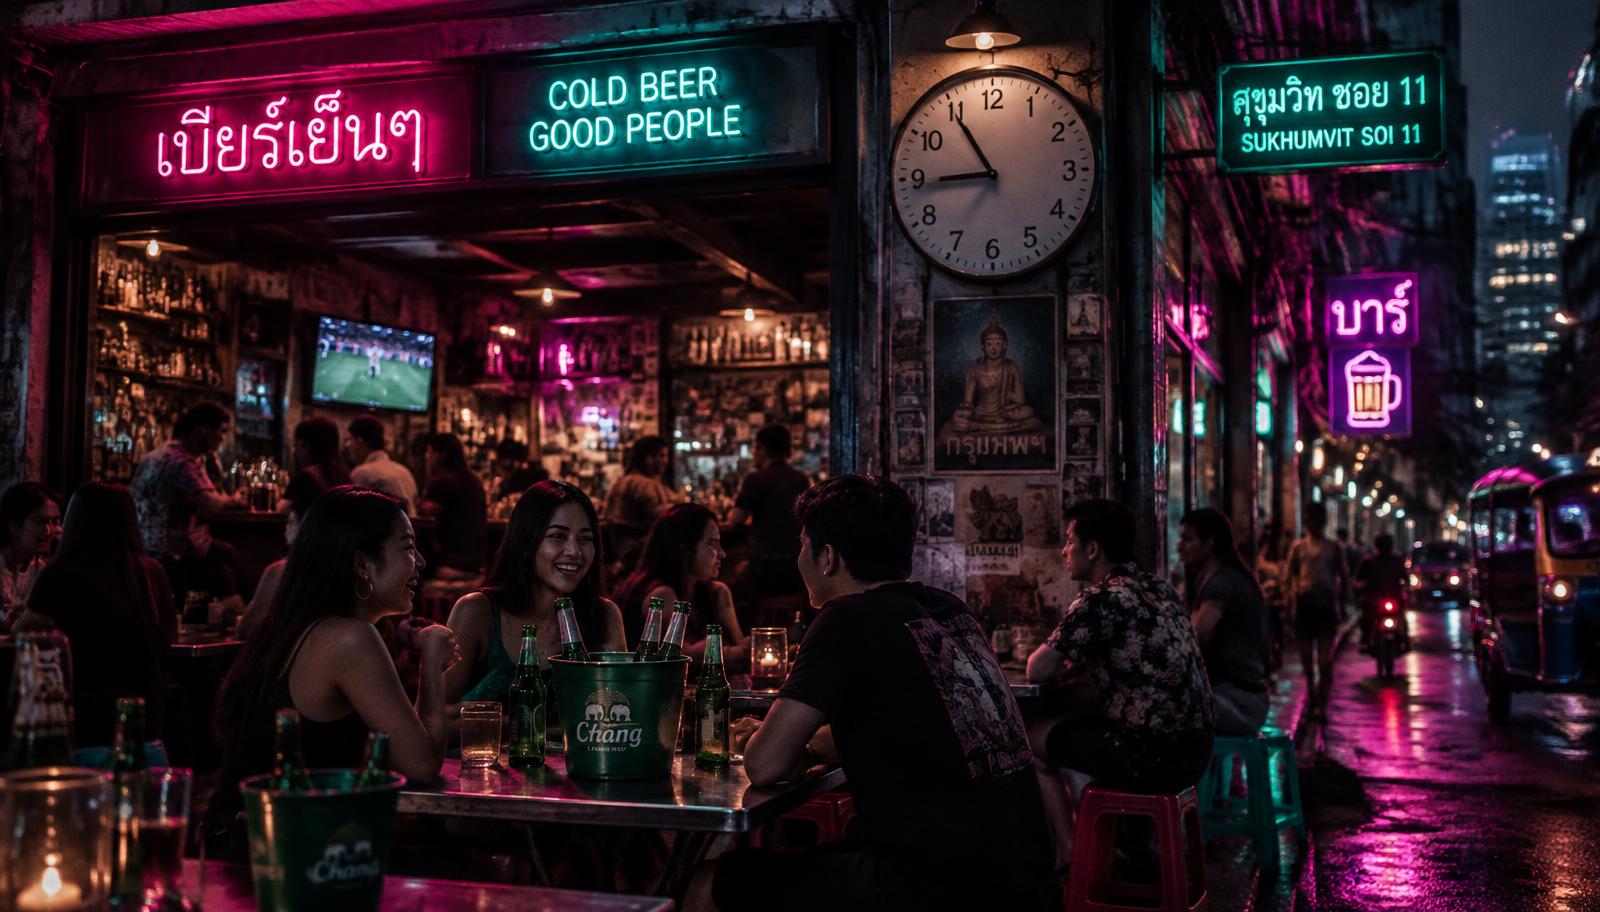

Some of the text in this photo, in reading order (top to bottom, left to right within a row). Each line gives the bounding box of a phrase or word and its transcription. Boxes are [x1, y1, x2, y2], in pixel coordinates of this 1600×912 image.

[549, 66, 717, 110] COLD BEER
[982, 88, 1004, 110] 12
[948, 101, 965, 122] 11
[1026, 95, 1034, 118] 1
[1233, 75, 1323, 127] สุขุมวิท
[1400, 75, 1426, 106] 11
[158, 89, 421, 176] เบียร์เย็นๆ
[529, 104, 741, 151] GOOD PEOPLE
[1051, 122, 1066, 143] 2
[1241, 123, 1420, 153] SUKHUMVIT SOI 11
[921, 130, 943, 151] 10
[911, 169, 925, 190] 9
[1062, 160, 1077, 181] 3
[922, 204, 937, 226] 8
[1049, 198, 1066, 219] 4
[950, 230, 964, 251] 7
[1023, 226, 1038, 248] 5
[985, 238, 1000, 259] 6
[1330, 279, 1412, 335] บาร์
[576, 721, 643, 748] Chang
